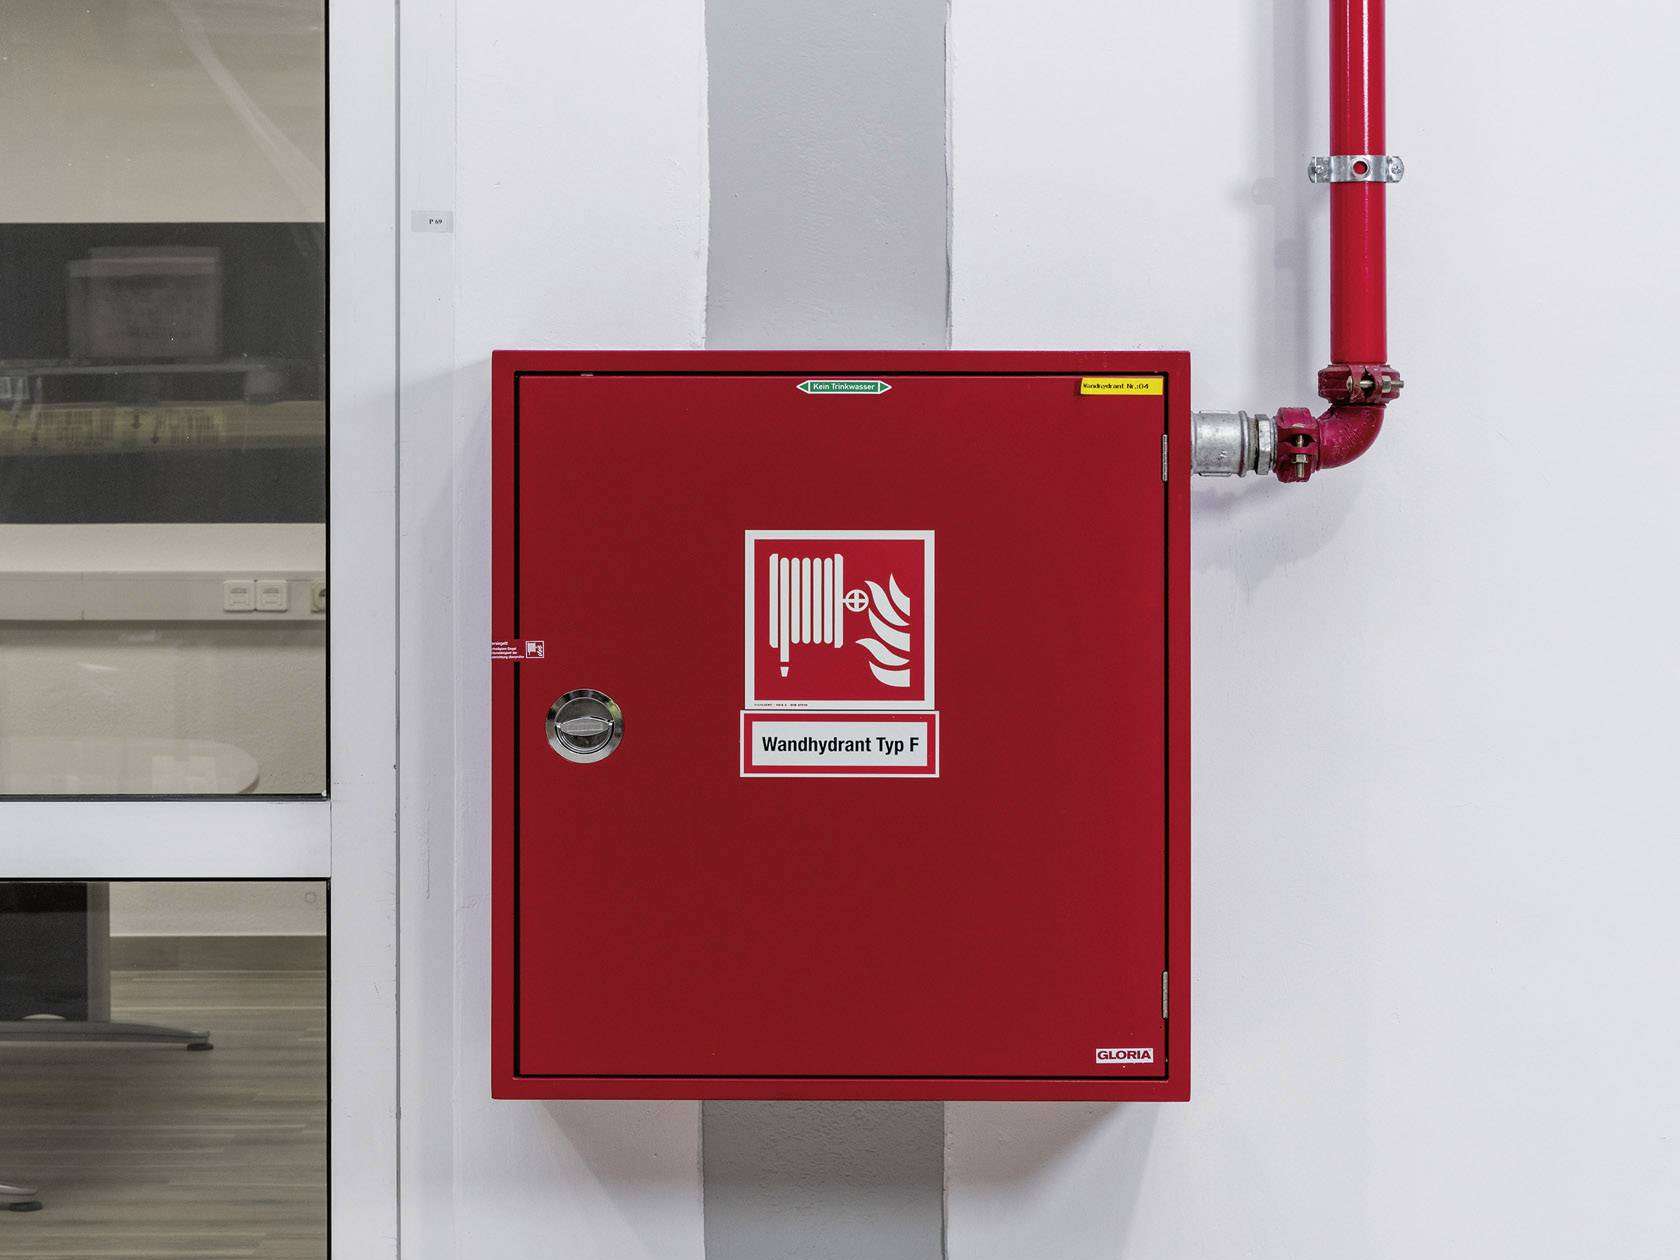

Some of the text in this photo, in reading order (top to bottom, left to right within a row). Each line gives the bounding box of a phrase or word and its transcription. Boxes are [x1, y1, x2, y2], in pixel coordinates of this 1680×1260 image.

[813, 383, 875, 391] Kein Trinkwasser
[762, 736, 920, 755] Wandhydrant Typ F
[1097, 1050, 1151, 1060] GLORIA
